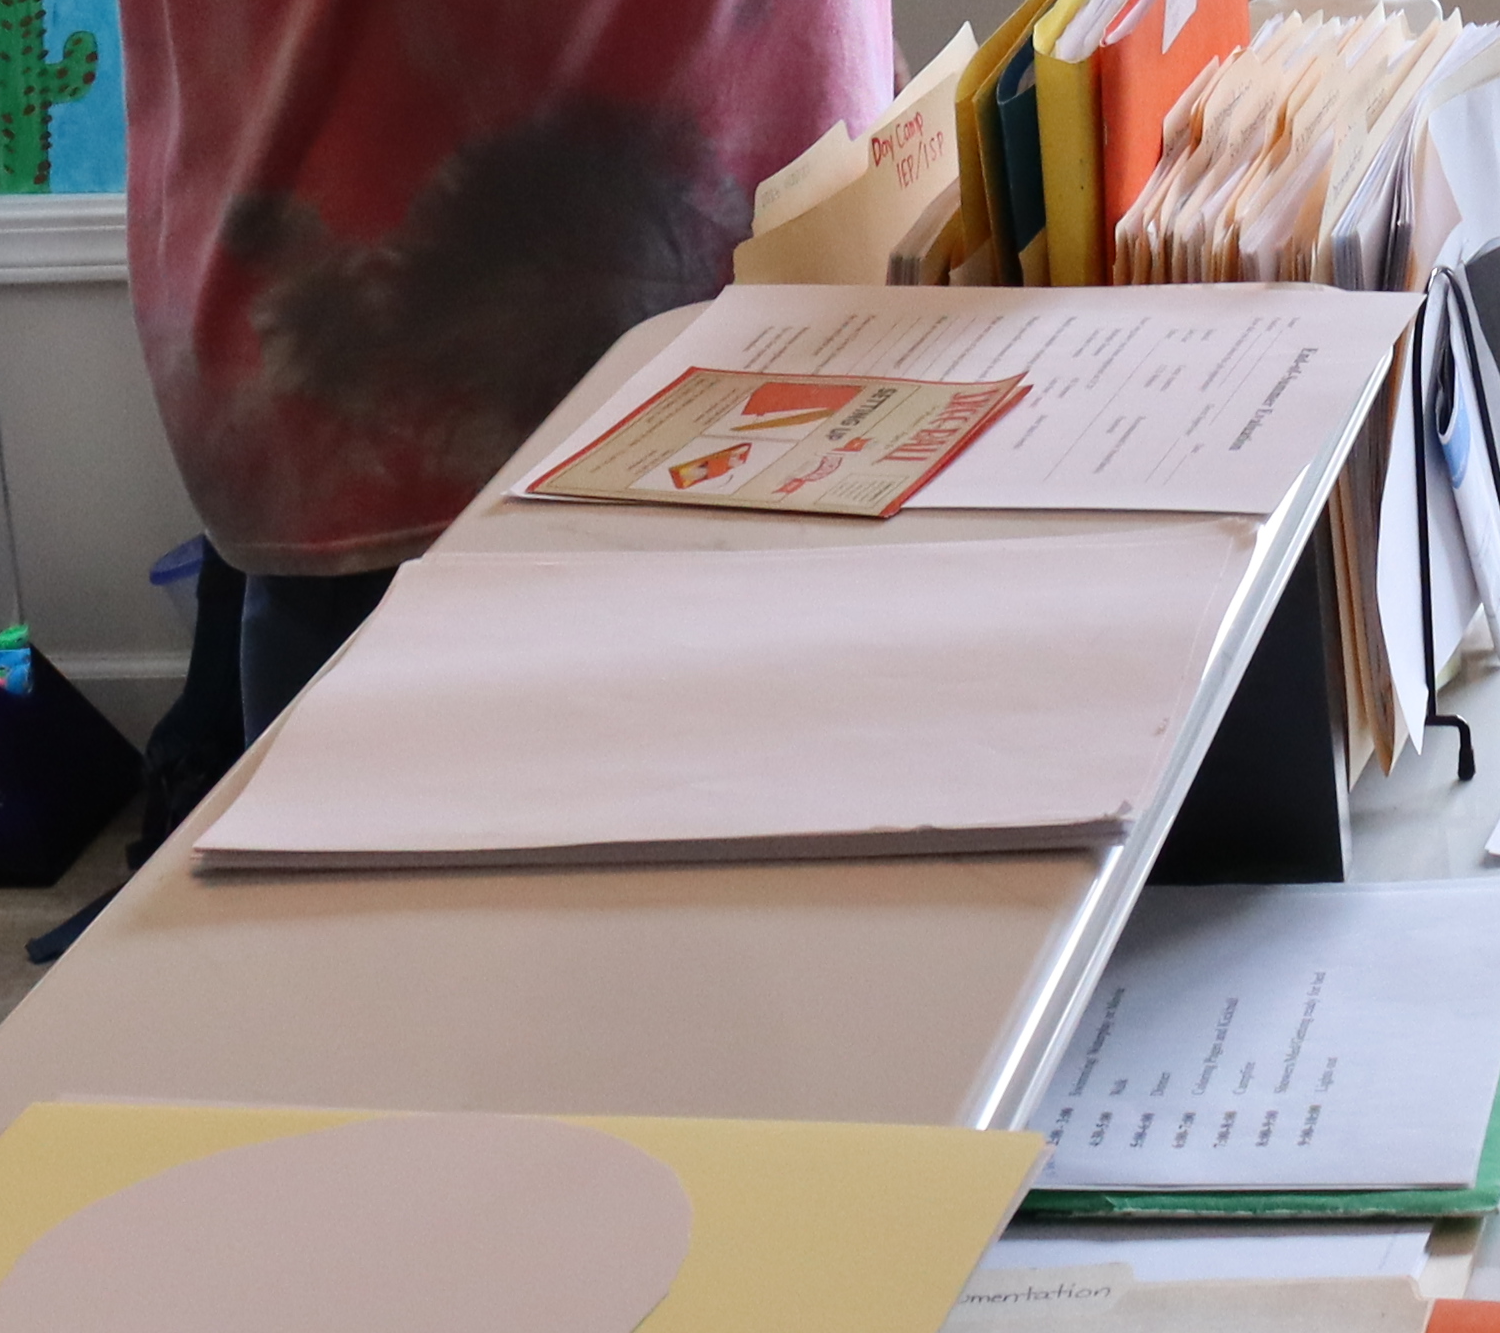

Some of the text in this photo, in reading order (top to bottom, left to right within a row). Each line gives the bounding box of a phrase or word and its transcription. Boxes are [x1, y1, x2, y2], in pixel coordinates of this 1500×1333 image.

[870, 110, 925, 167] Day Camp
[825, 387, 898, 441] SETTING UP
[1203, 1042, 1224, 1064] Pages
[1149, 1071, 1171, 1097] Dinner
[1191, 1064, 1219, 1096] Coloring
[1232, 1061, 1256, 1095] Campfire
[1314, 1069, 1335, 1093] Lights
